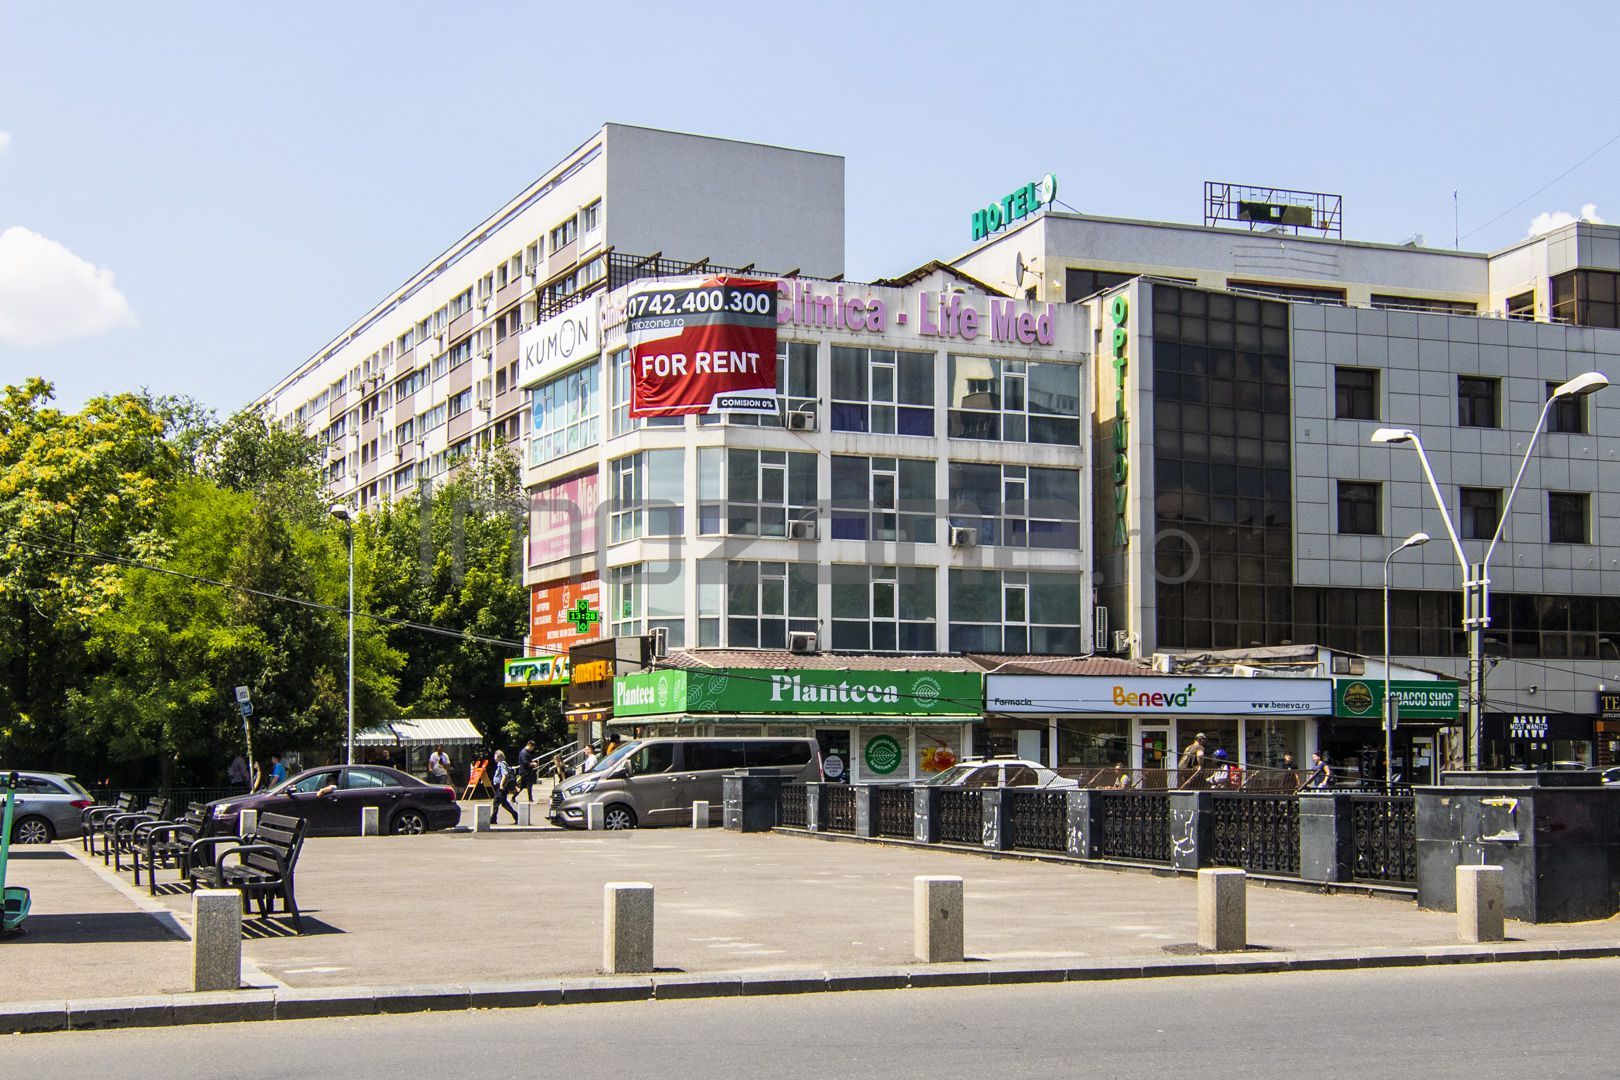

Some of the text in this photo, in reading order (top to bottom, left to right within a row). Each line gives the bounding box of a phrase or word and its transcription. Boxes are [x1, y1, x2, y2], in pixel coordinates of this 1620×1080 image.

[971, 181, 1041, 241] HOTEL
[628, 290, 770, 318] 0742.400.300
[776, 280, 1055, 345] Clinica Life Med
[525, 316, 588, 371] KUMON
[641, 351, 760, 379] FOR RENT
[721, 399, 773, 408] COMISION 0%
[1112, 295, 1129, 547] OPTINOVA
[616, 681, 655, 706] Planteea
[769, 674, 900, 704] Planteea
[1112, 685, 1188, 707] Beneva
[1429, 692, 1454, 707] SHOP
[1251, 701, 1310, 709] www.beneva.ro
